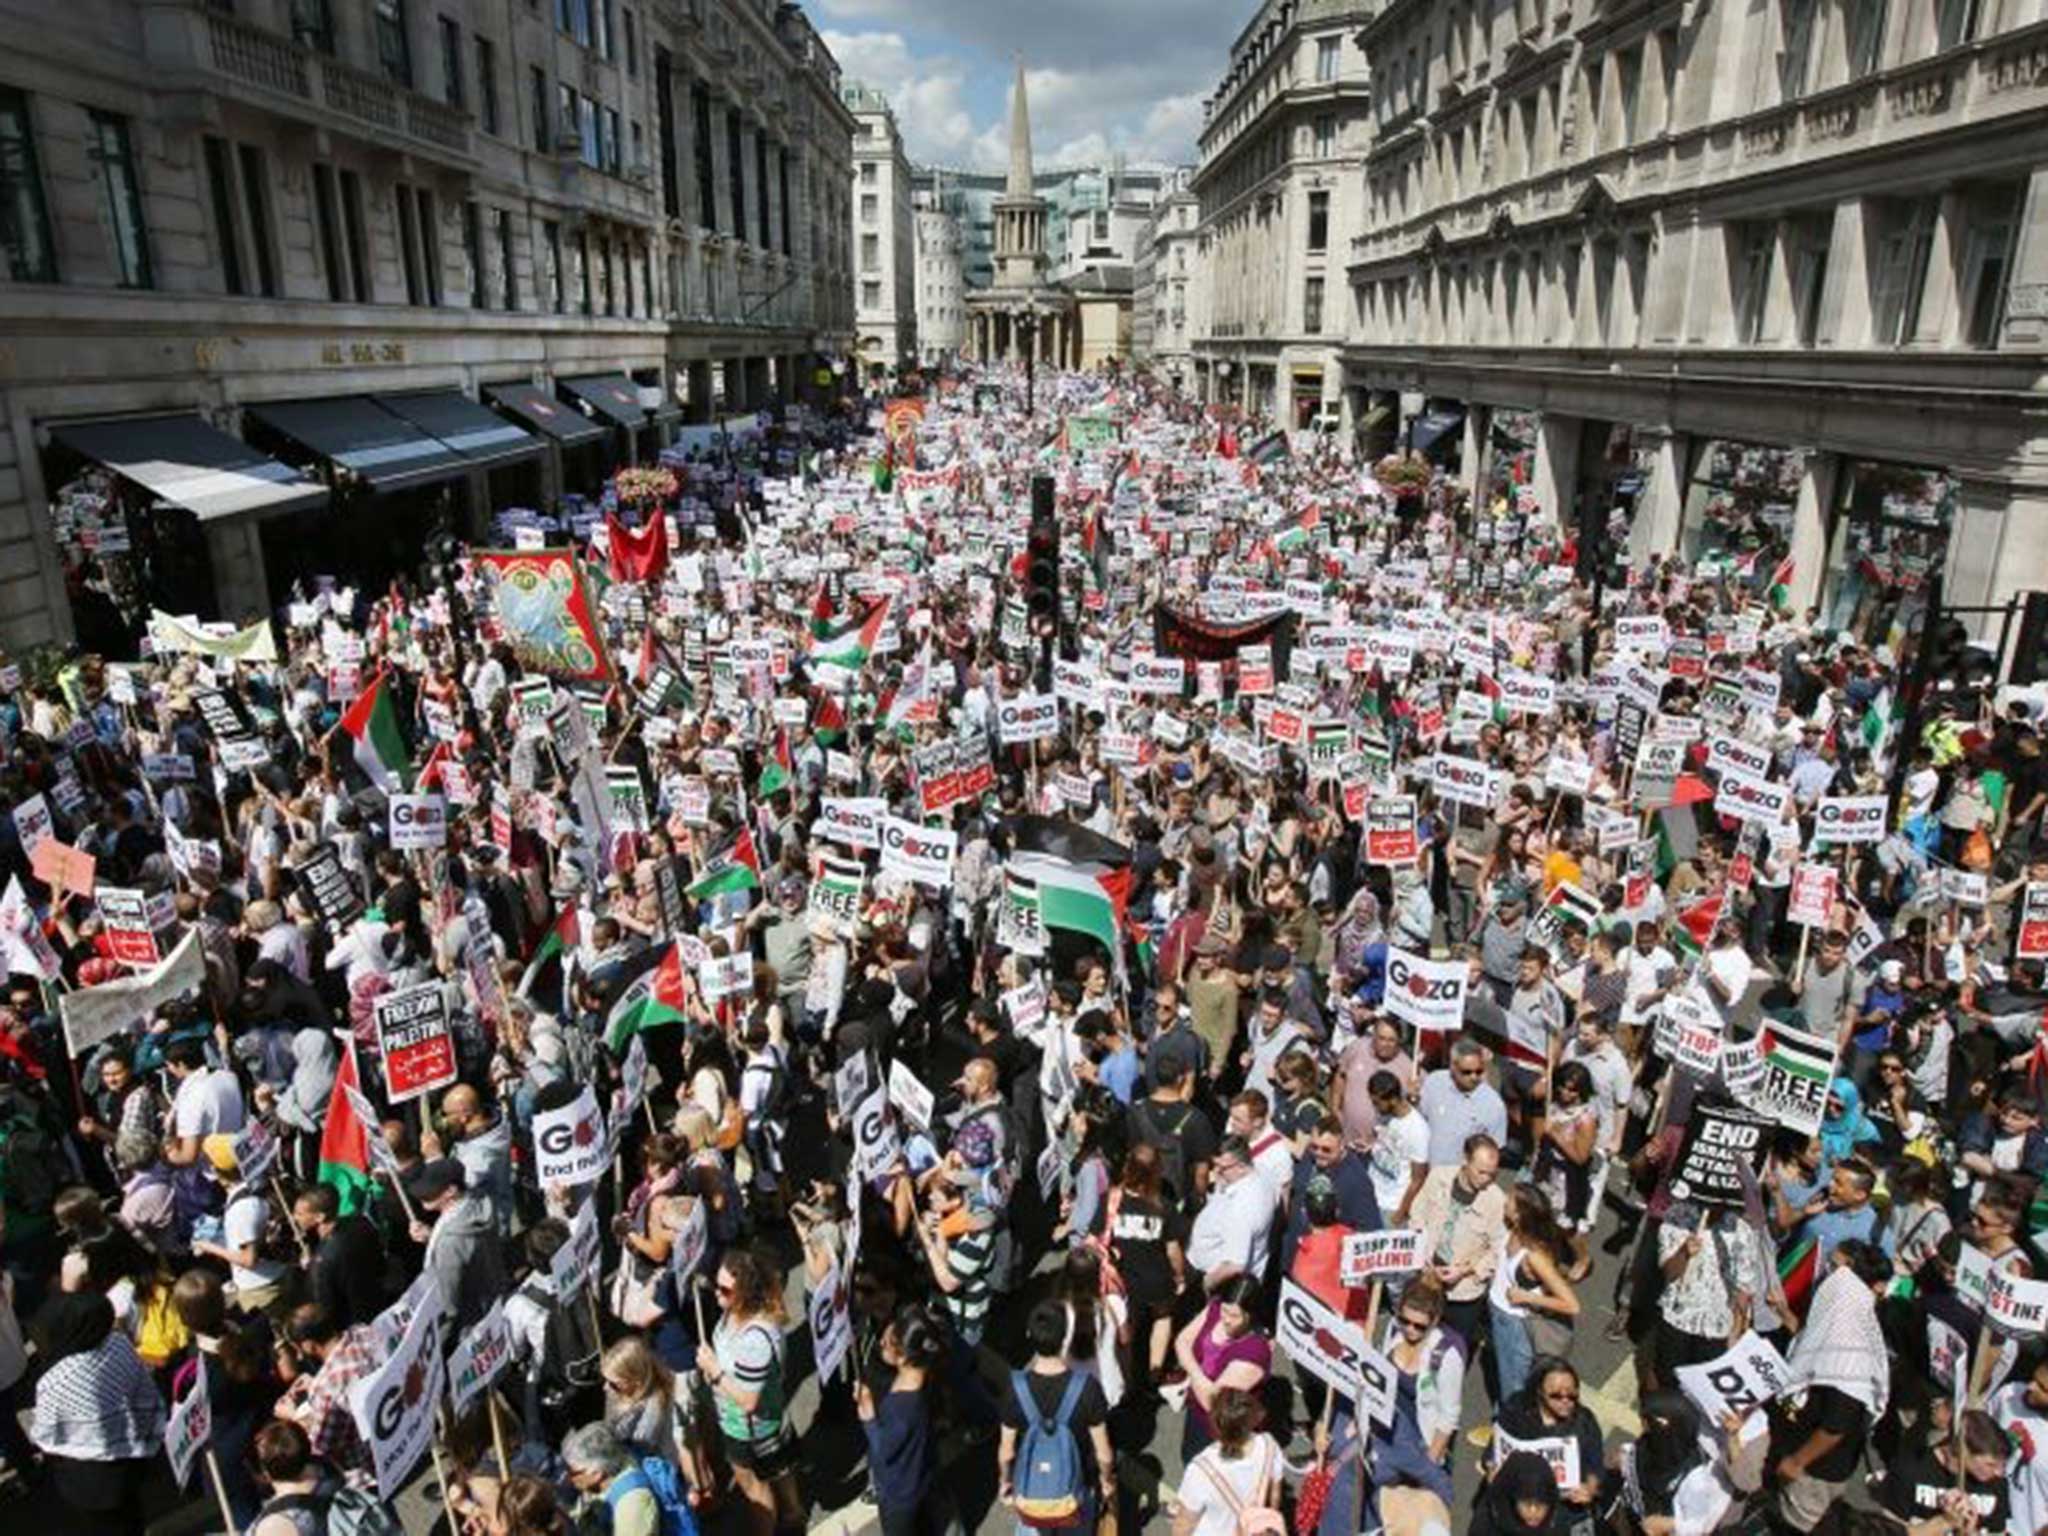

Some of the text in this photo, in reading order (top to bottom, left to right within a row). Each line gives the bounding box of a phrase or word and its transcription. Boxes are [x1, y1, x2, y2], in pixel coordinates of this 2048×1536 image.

[1211, 580, 1243, 592] Gza
[1287, 585, 1319, 602] Gza
[1618, 622, 1659, 634] Gza
[1310, 634, 1348, 647] Gza
[1368, 639, 1410, 658] Gza
[732, 645, 769, 661] Gza
[1055, 665, 1092, 689] Gza
[1134, 662, 1180, 679] Gza
[1627, 667, 1659, 696] Gza
[1504, 681, 1550, 699] Gza
[1001, 704, 1055, 725] Gza
[1714, 740, 1765, 770] Gza
[1436, 760, 1485, 788] Gza
[1722, 778, 1782, 809] Gza
[824, 805, 873, 829] Gza
[1820, 804, 1881, 823] Gza
[886, 827, 949, 860] Gza
[1389, 958, 1461, 1001] Gza
[1769, 1064, 1825, 1106] REE
[1701, 1119, 1760, 1149] END
[1391, 1235, 1417, 1249] THE
[1961, 1266, 2044, 1321] PASTINE
[1284, 1298, 1387, 1394] Gza
